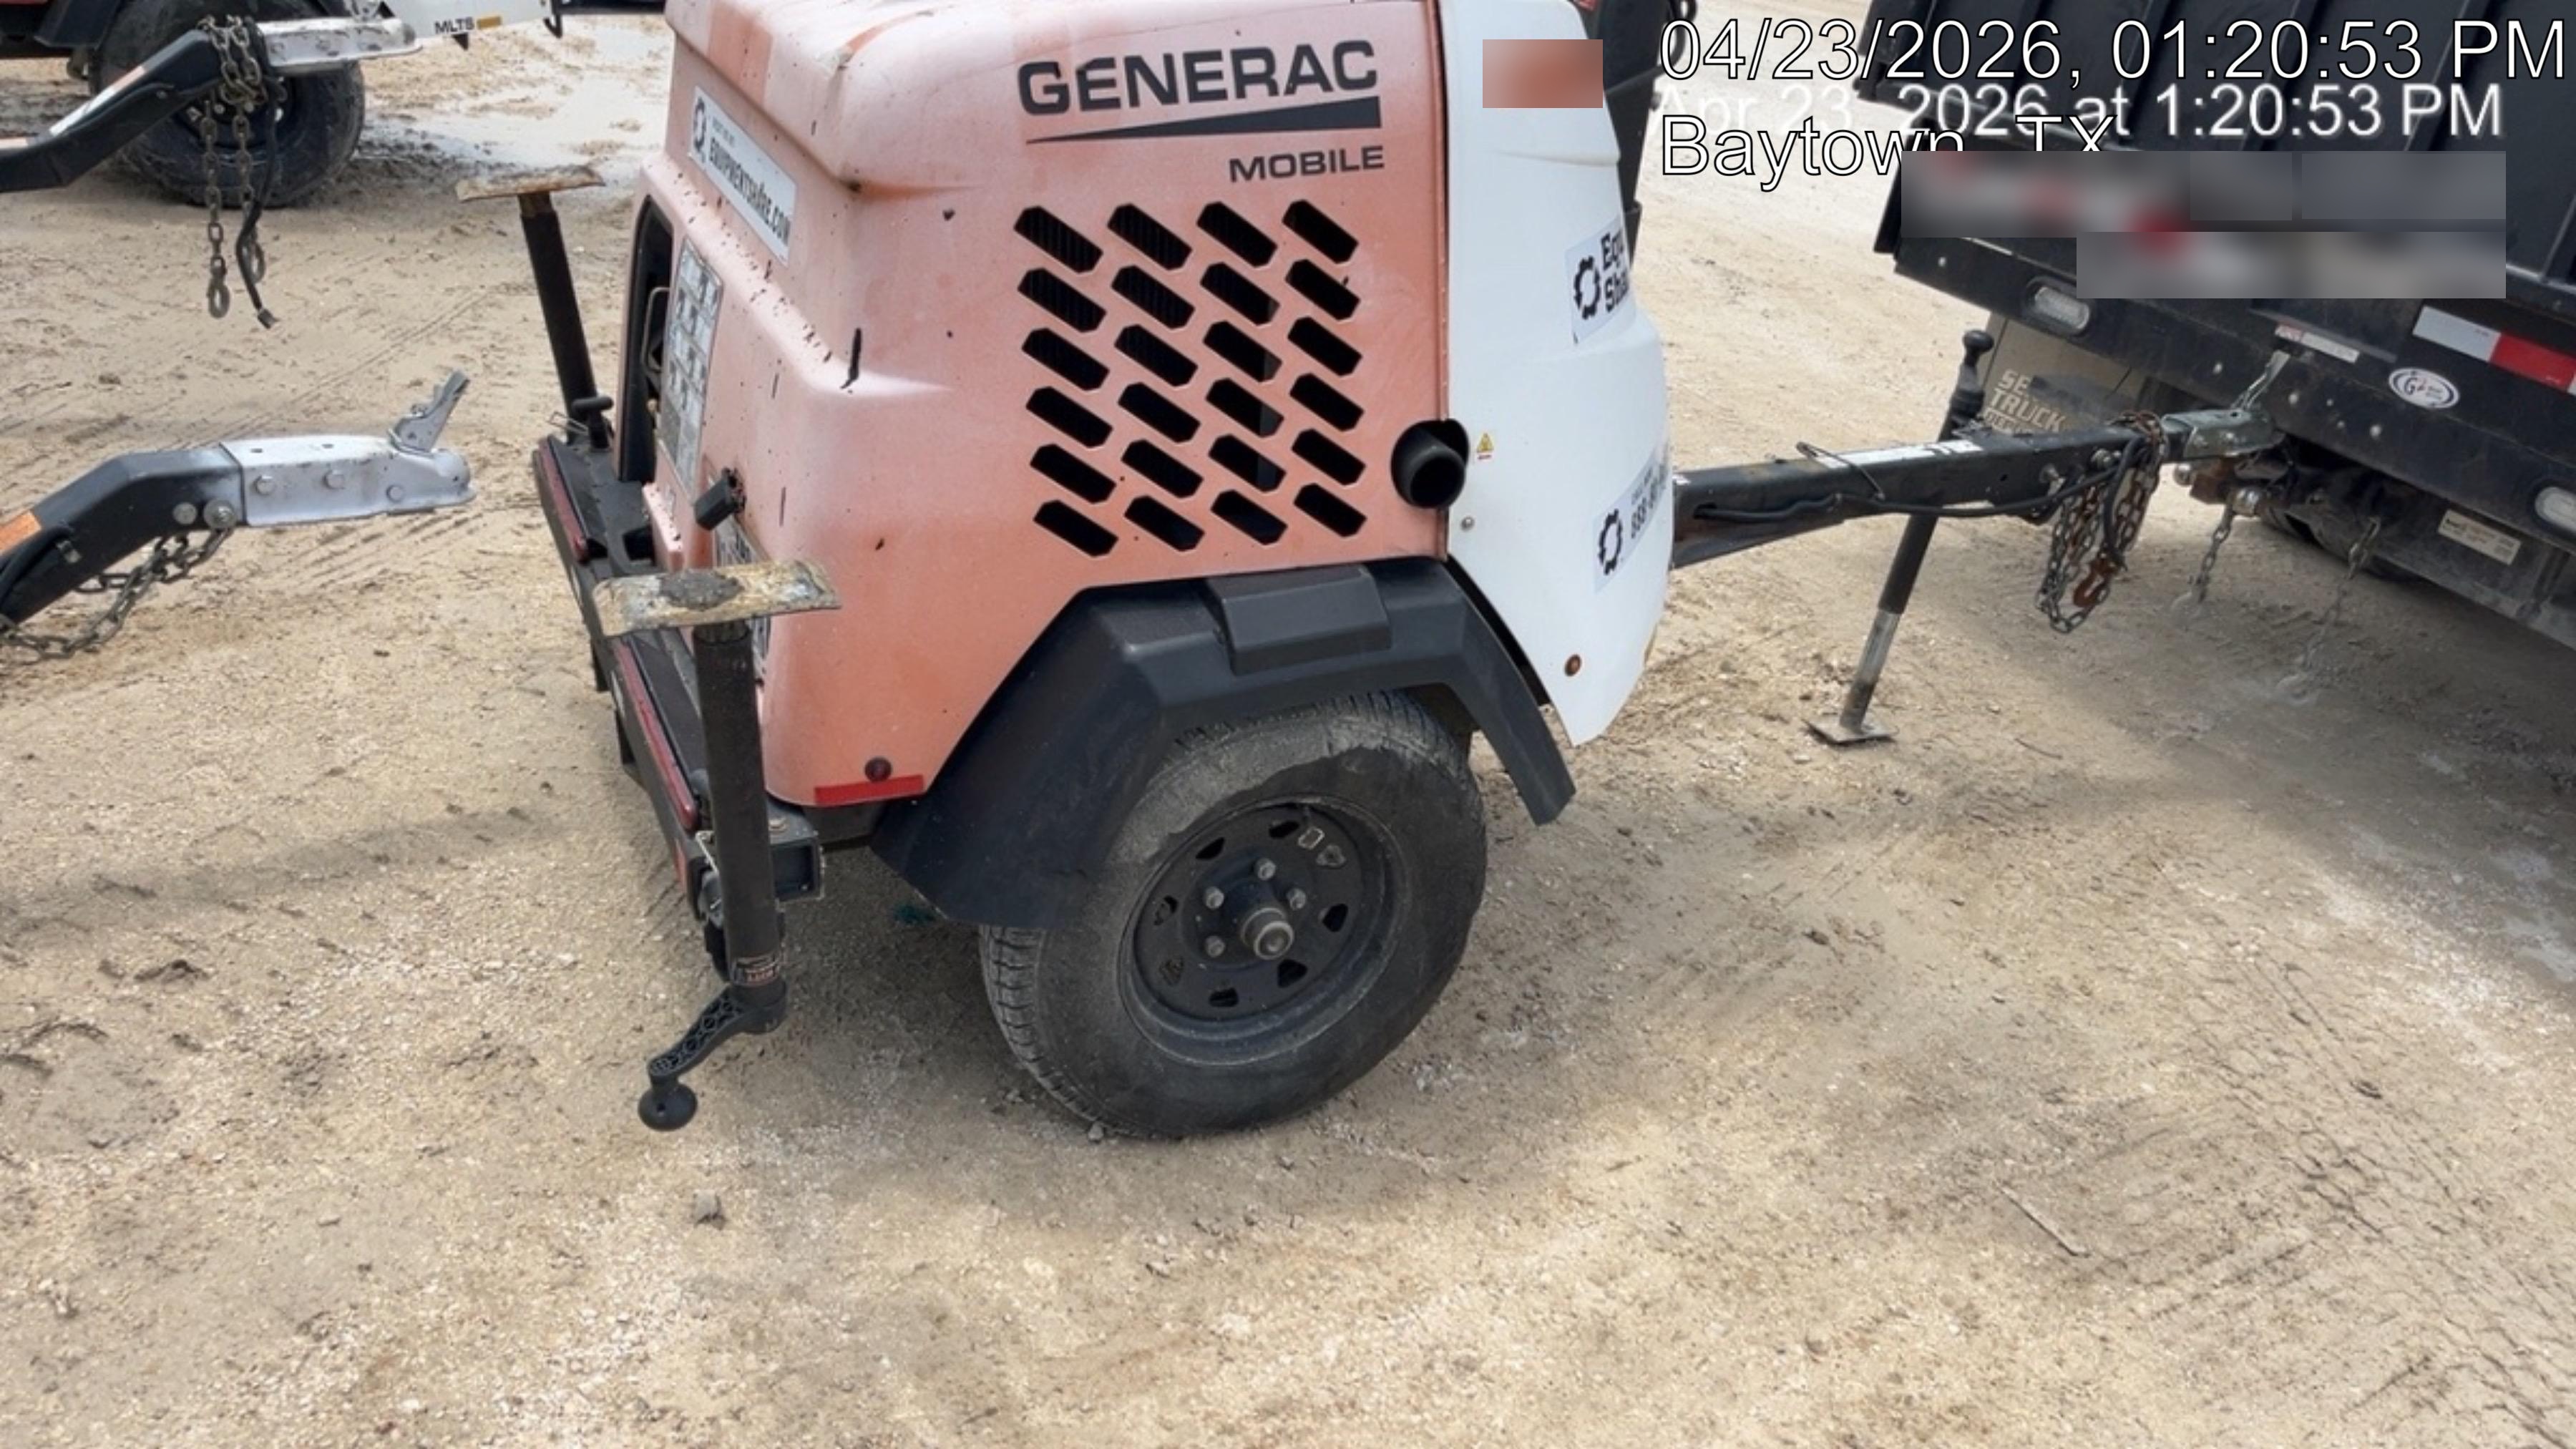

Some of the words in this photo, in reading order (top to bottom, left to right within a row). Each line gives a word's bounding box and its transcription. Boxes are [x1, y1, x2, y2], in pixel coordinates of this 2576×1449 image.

[1016, 39, 1378, 116] GENERAC
[1228, 145, 1385, 184] MOBILE
[1991, 387, 2067, 433] TRUCK
